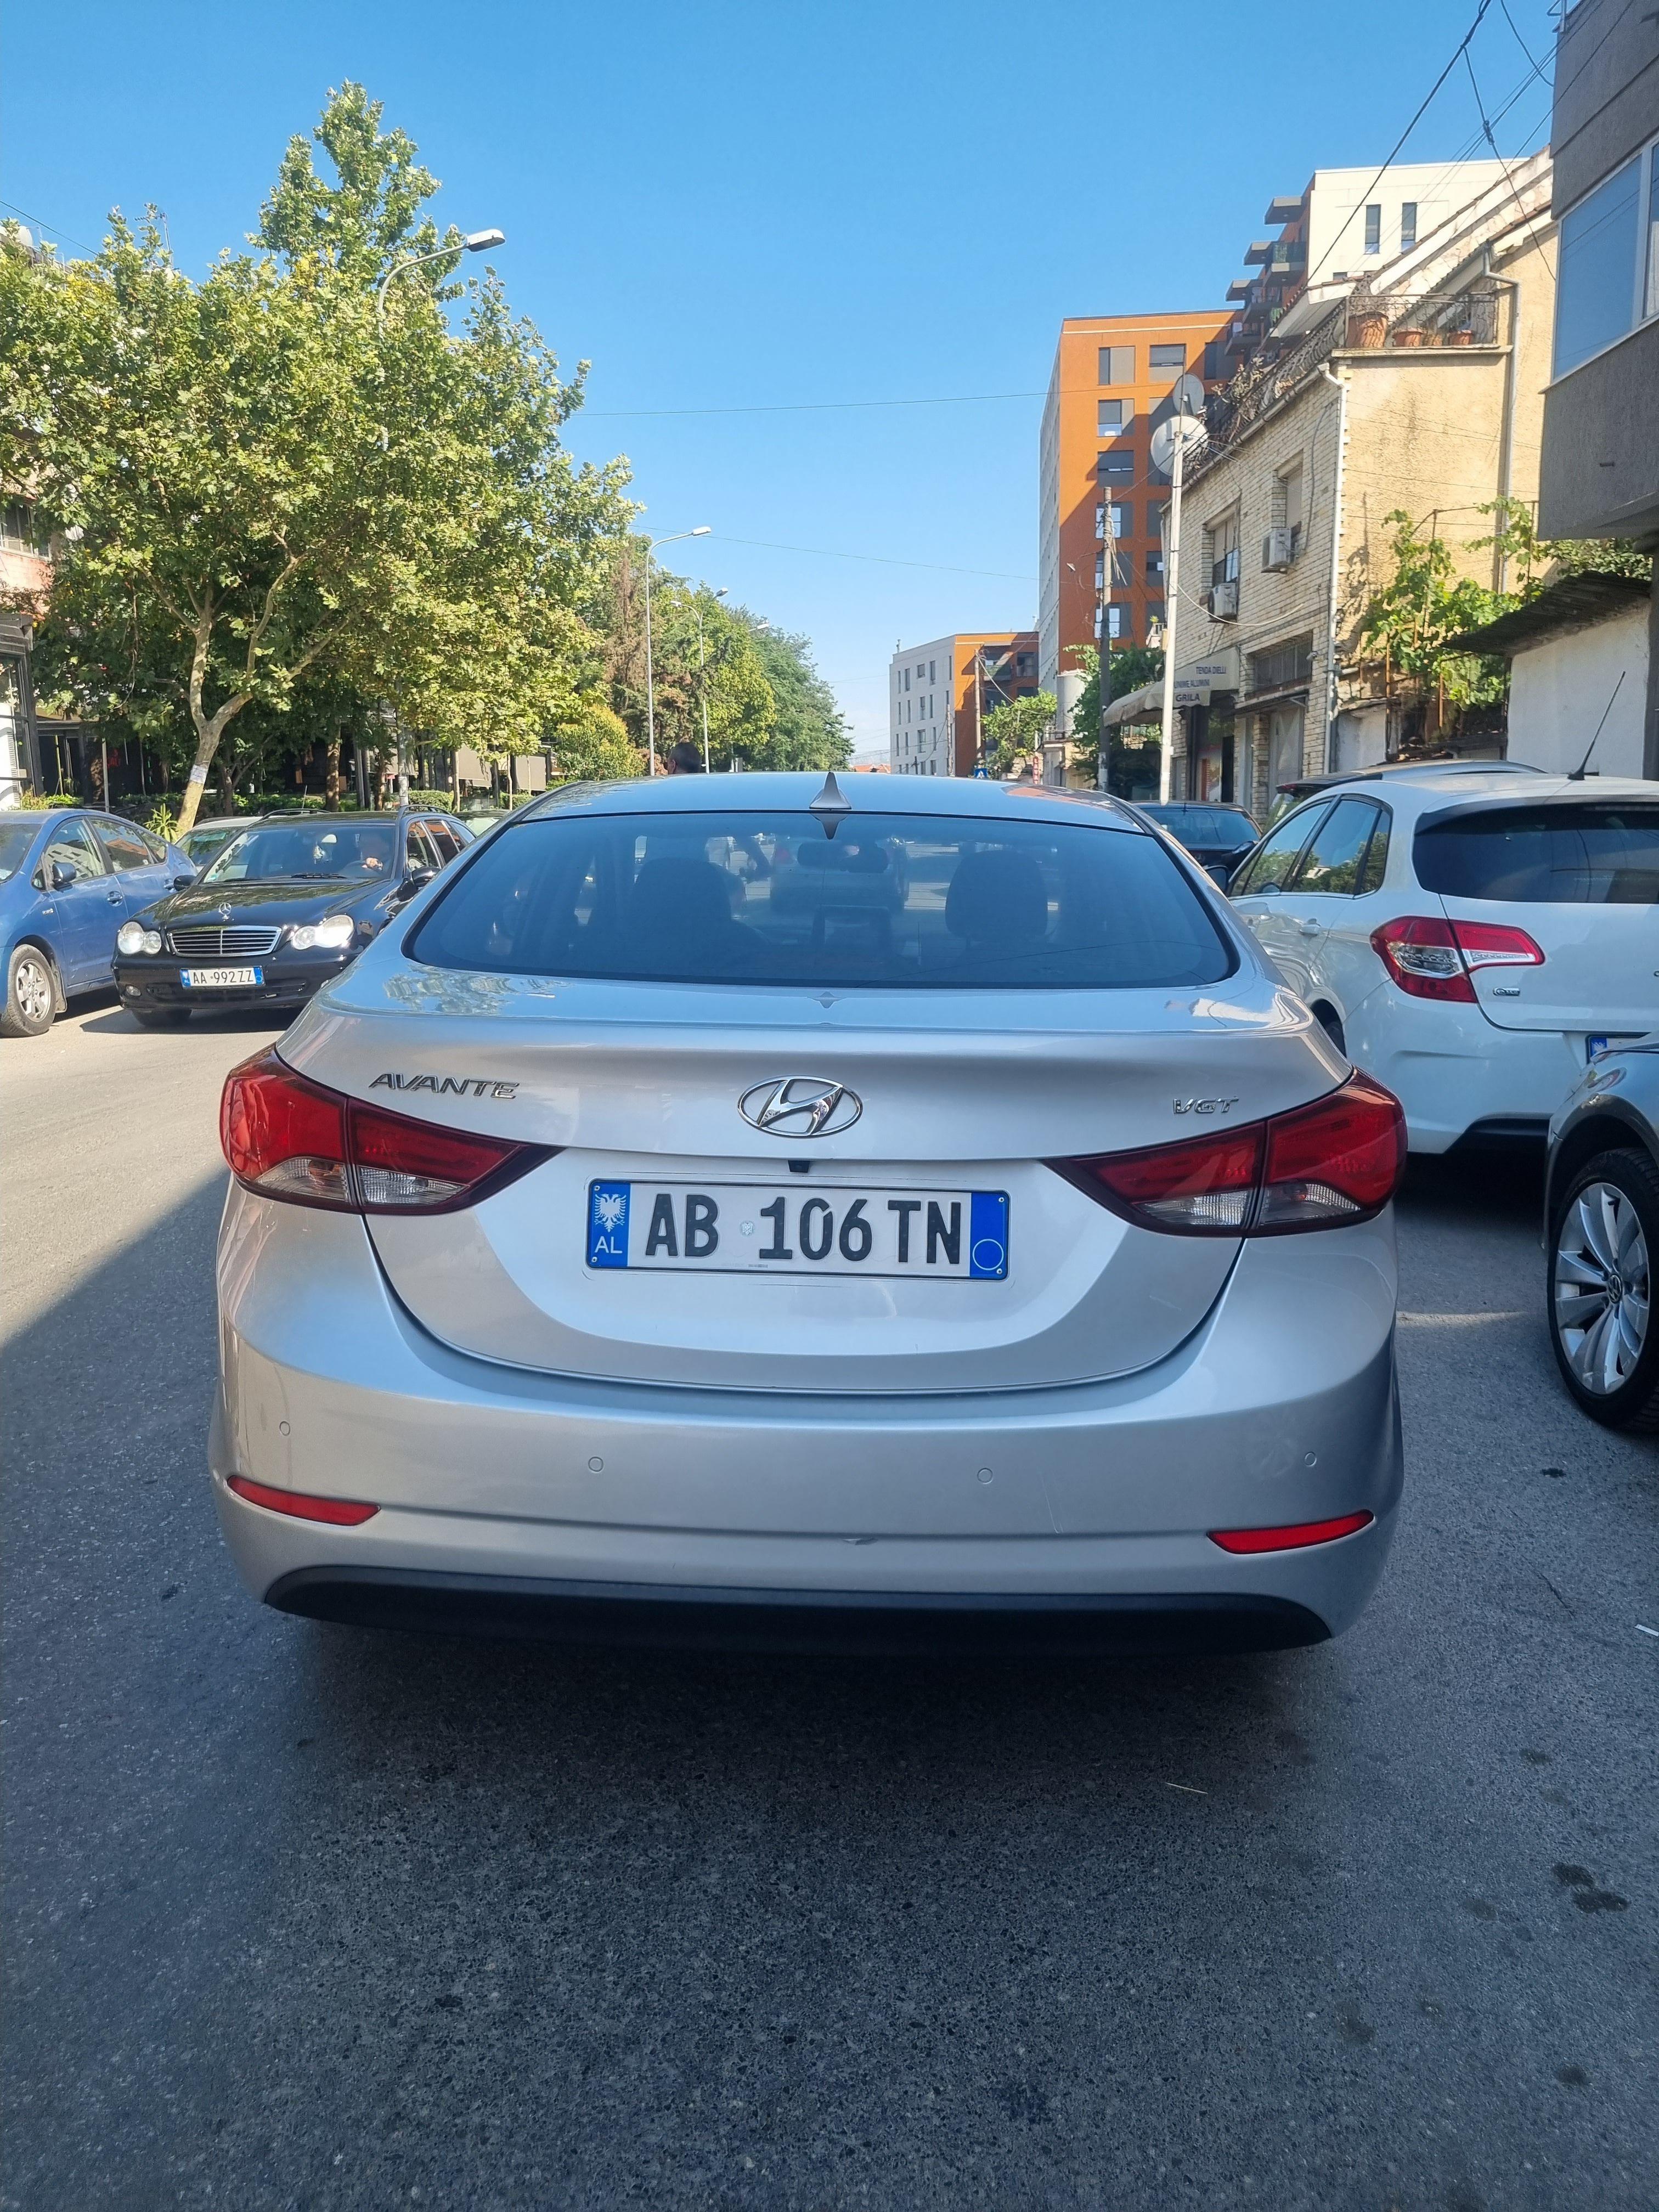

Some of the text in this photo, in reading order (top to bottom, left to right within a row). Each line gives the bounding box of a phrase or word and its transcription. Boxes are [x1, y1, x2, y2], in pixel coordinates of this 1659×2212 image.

[193, 972, 207, 984] AA
[368, 1073, 520, 1099] AVANTE
[1173, 1097, 1239, 1114] VGT
[645, 1193, 962, 1265] AB 106 TN
[595, 1235, 623, 1254] AL
